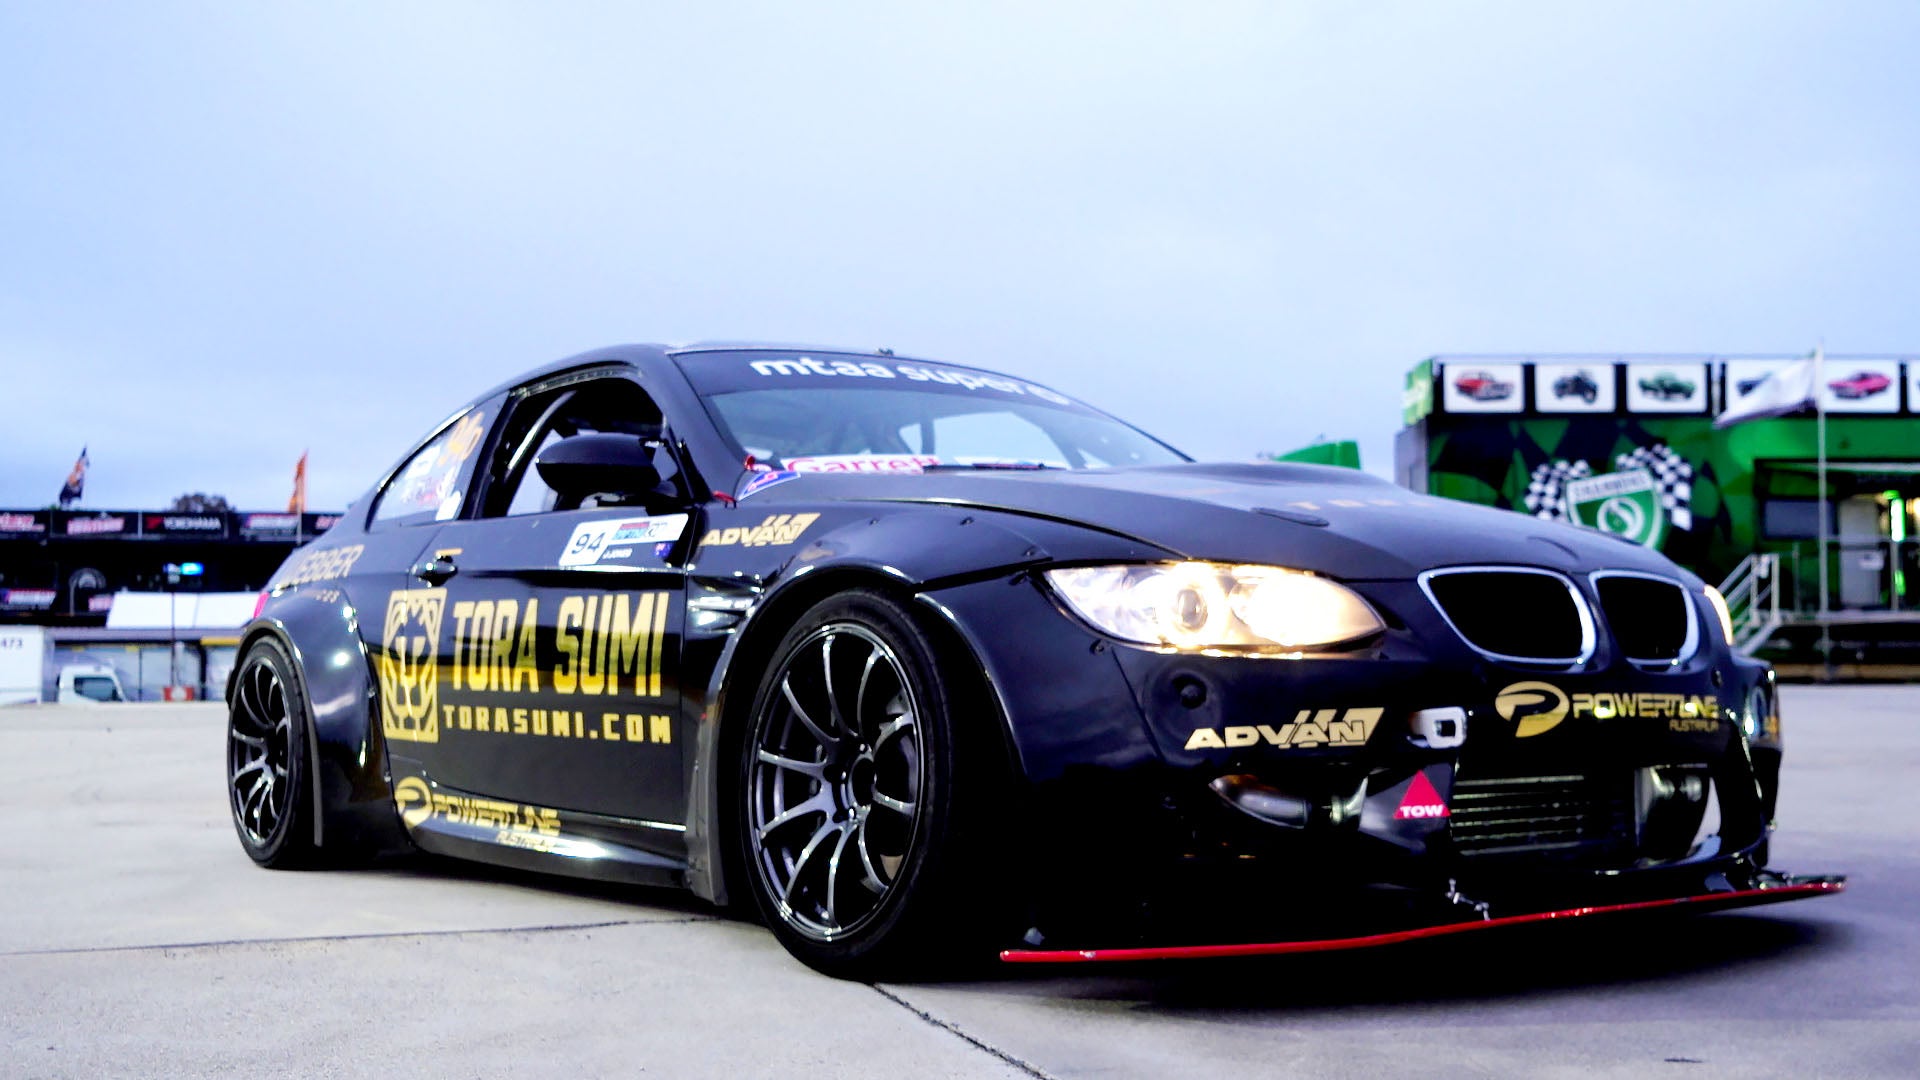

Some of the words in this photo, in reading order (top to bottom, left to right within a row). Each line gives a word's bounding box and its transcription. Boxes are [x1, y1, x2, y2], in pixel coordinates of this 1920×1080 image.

[750, 357, 896, 378] mtaa
[898, 365, 1025, 394] super
[571, 531, 607, 554] 94
[699, 512, 821, 547] ADVAN
[452, 598, 540, 693] TORA
[553, 592, 670, 697] SUMI
[443, 704, 672, 744] TORASUMI.COM
[1184, 706, 1385, 750] ADVAN
[1400, 804, 1445, 818] TOW
